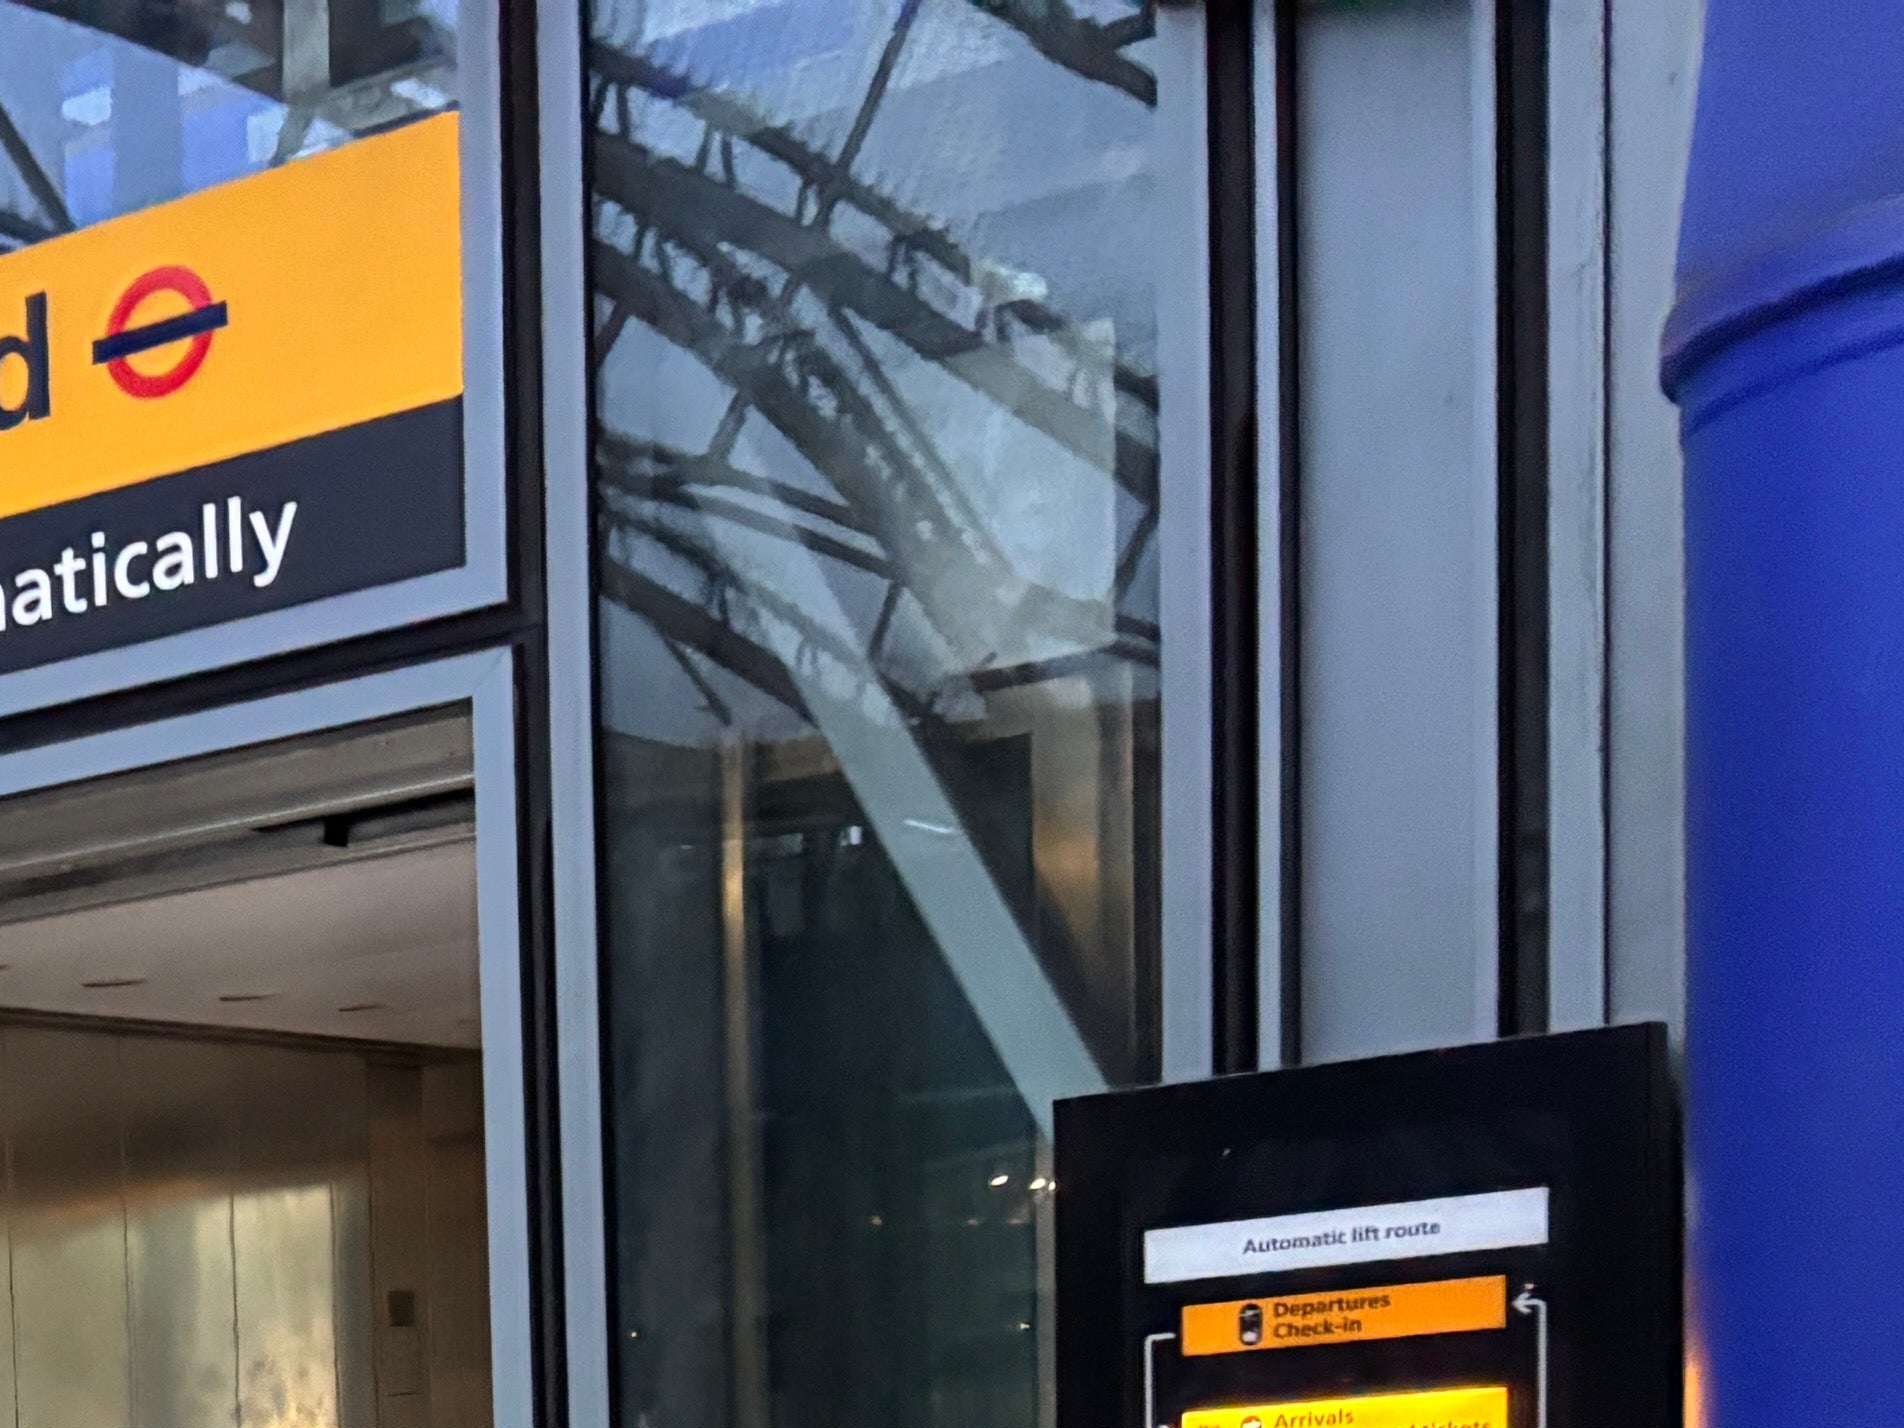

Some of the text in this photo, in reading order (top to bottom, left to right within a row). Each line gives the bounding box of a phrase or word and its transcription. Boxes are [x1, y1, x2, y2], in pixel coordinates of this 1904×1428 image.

[1242, 1220, 1441, 1255] Automatic lift route
[1273, 1294, 1391, 1319] Departures
[1273, 1317, 1362, 1339] Check-in
[1274, 1408, 1354, 1428] Arrivals
